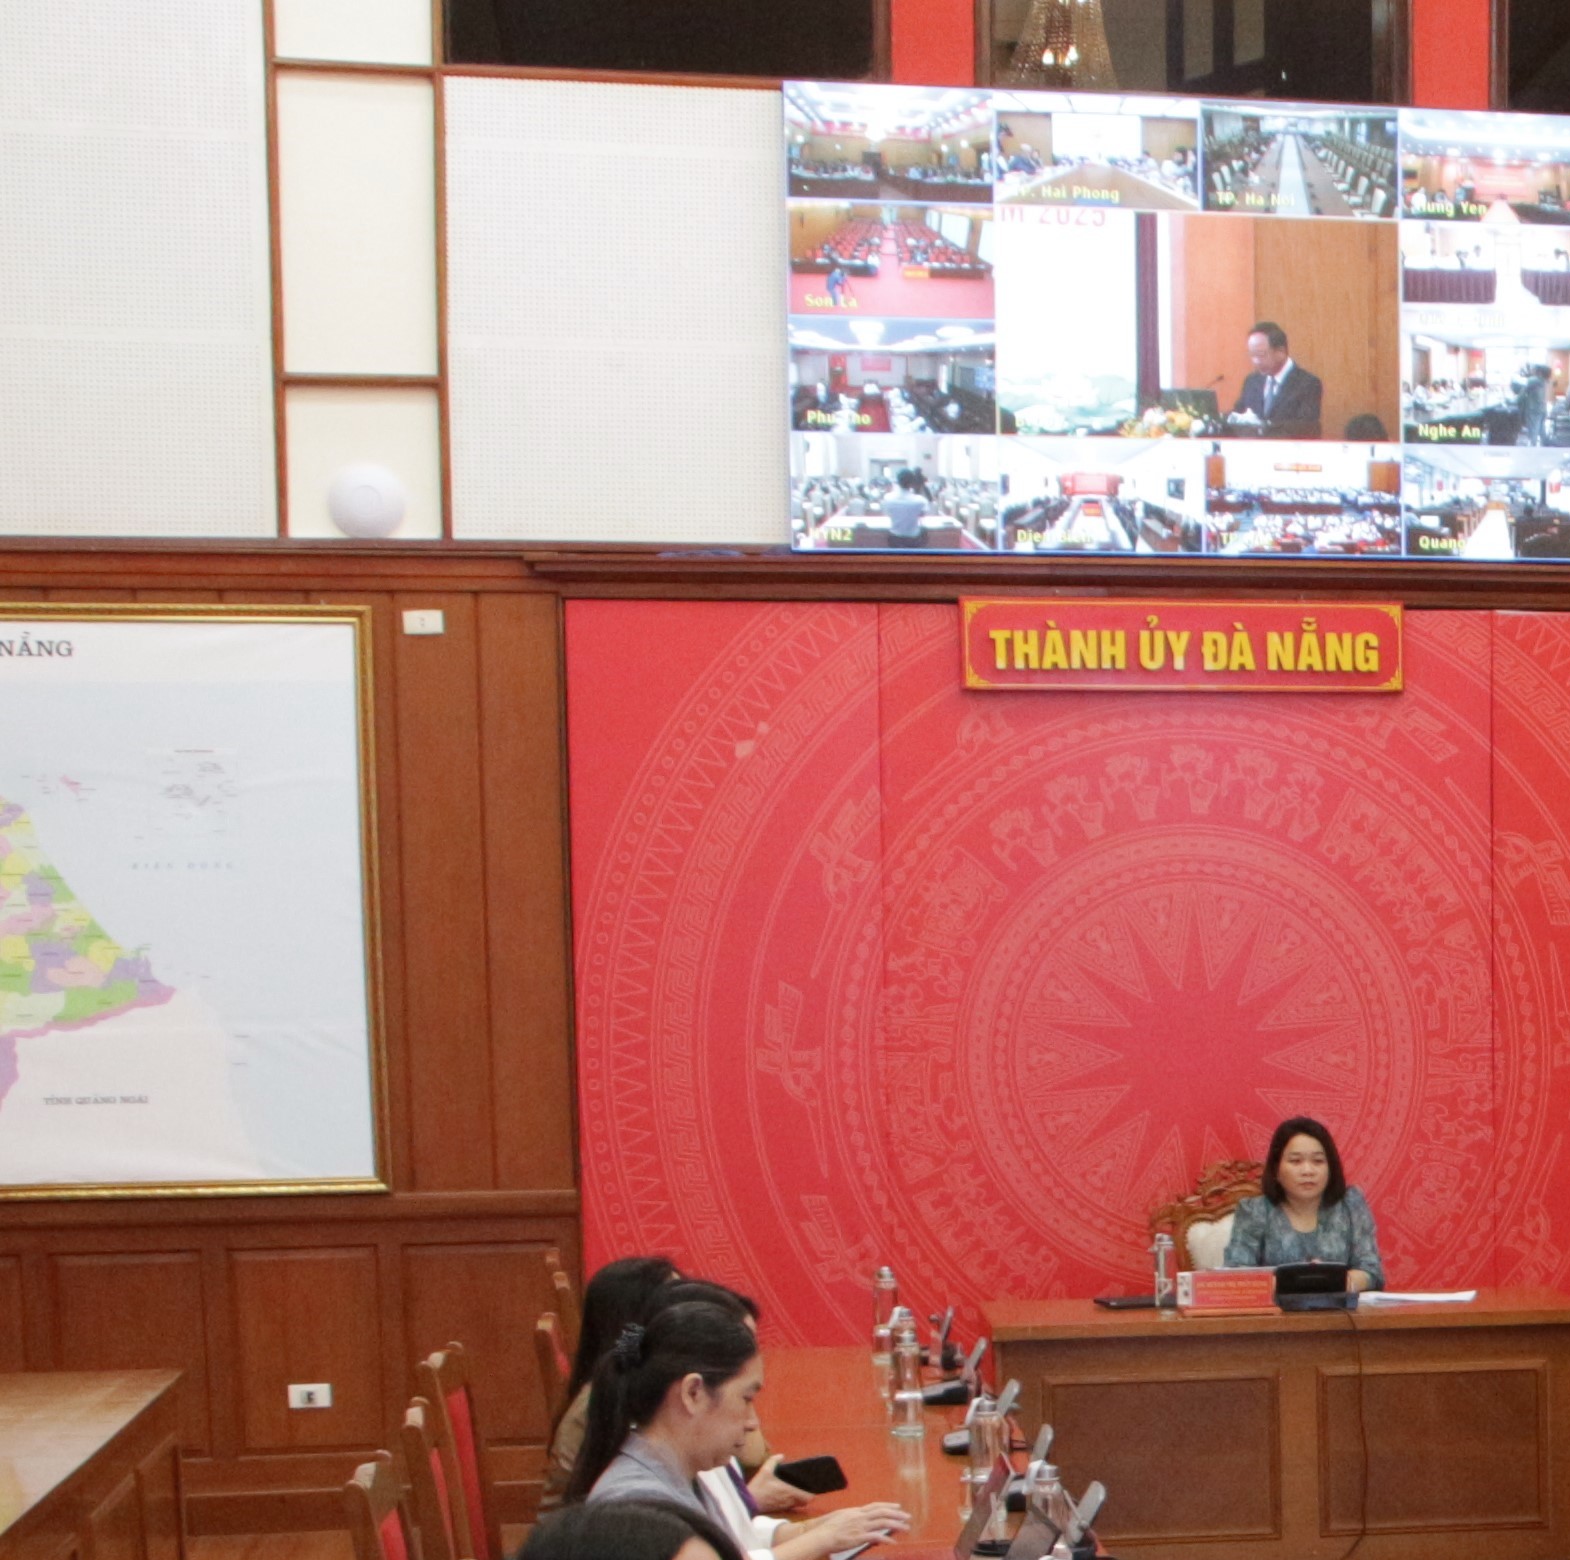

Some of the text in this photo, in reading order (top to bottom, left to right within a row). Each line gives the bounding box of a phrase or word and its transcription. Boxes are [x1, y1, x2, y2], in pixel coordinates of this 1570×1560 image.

[1041, 184, 1067, 199] Hai
[1072, 185, 1120, 204] Phong
[1245, 191, 1265, 206] Ha
[1460, 201, 1487, 215] Yen
[805, 293, 834, 308] Son
[807, 409, 836, 425] Phu
[1418, 423, 1481, 441] Nghe An
[989, 614, 1380, 673] THÀNH ỦY ĐÀ NẴNG
